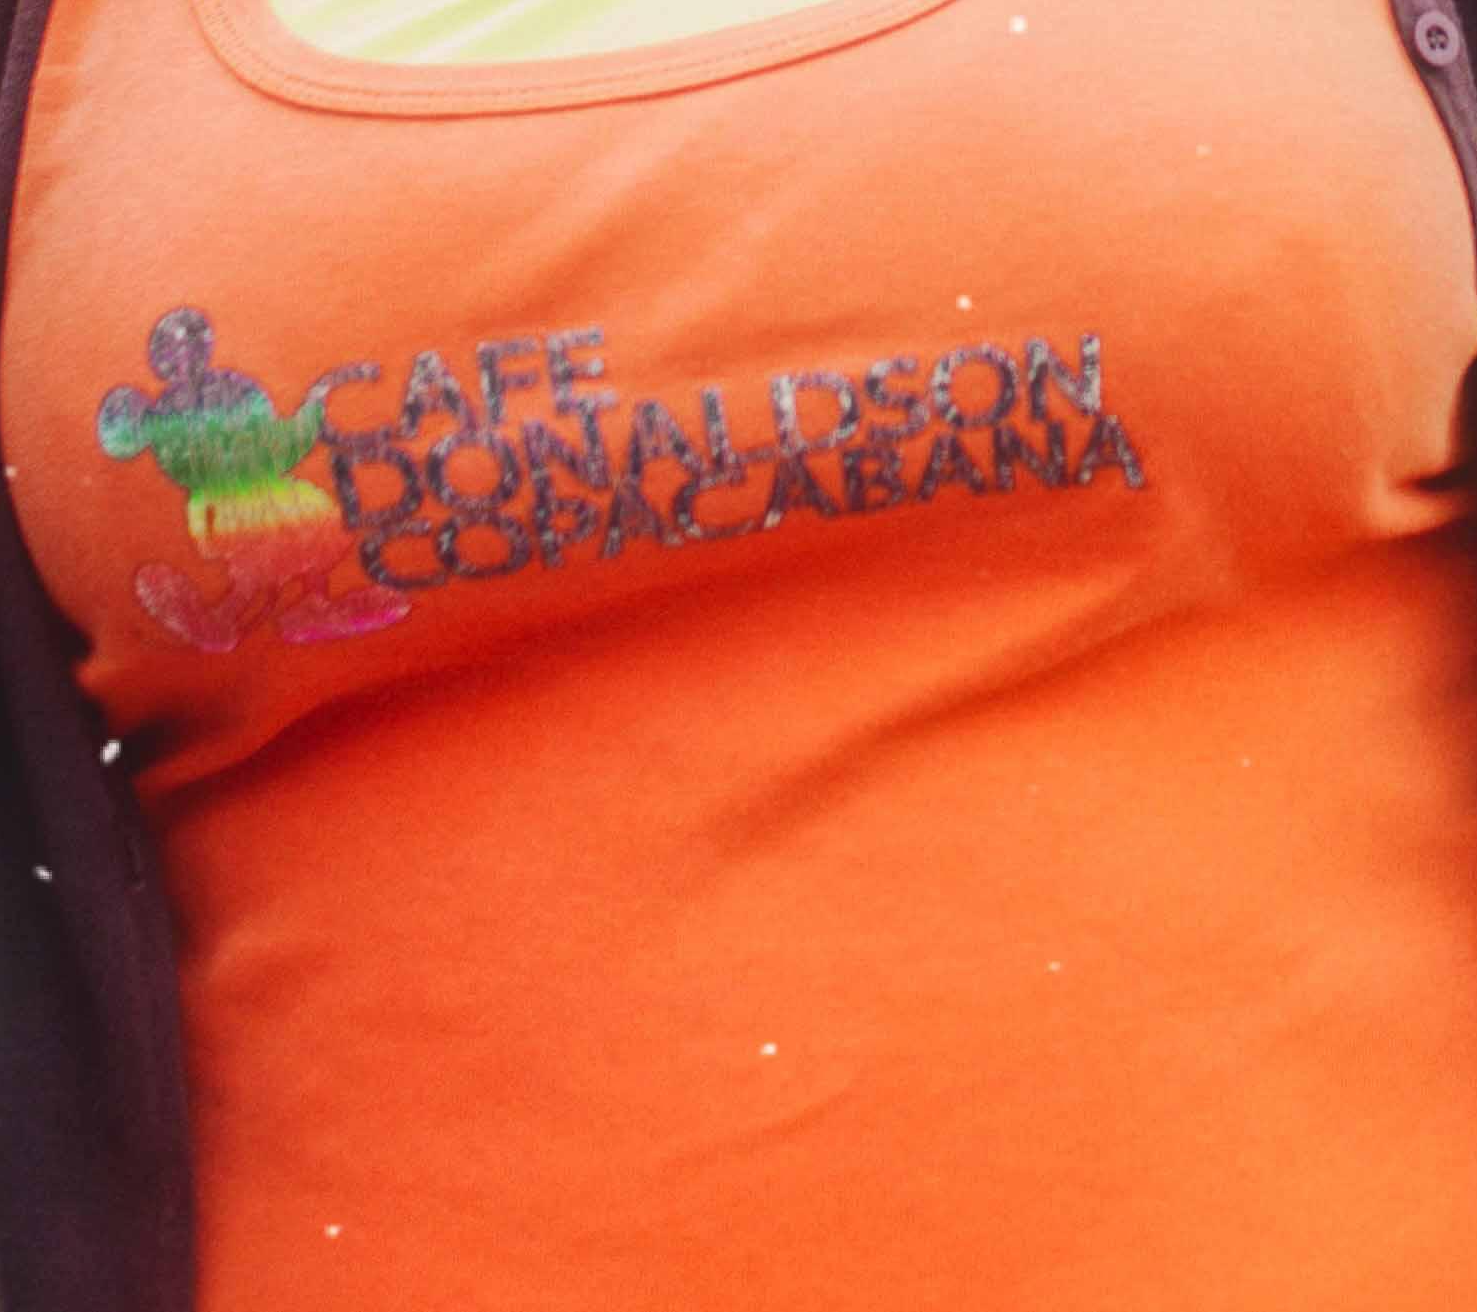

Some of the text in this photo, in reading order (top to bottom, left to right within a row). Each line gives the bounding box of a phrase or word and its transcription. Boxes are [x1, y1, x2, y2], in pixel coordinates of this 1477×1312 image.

[320, 325, 614, 455] CAFE
[330, 332, 1104, 532] DONALDSON
[358, 413, 1148, 591] COPACABANA
